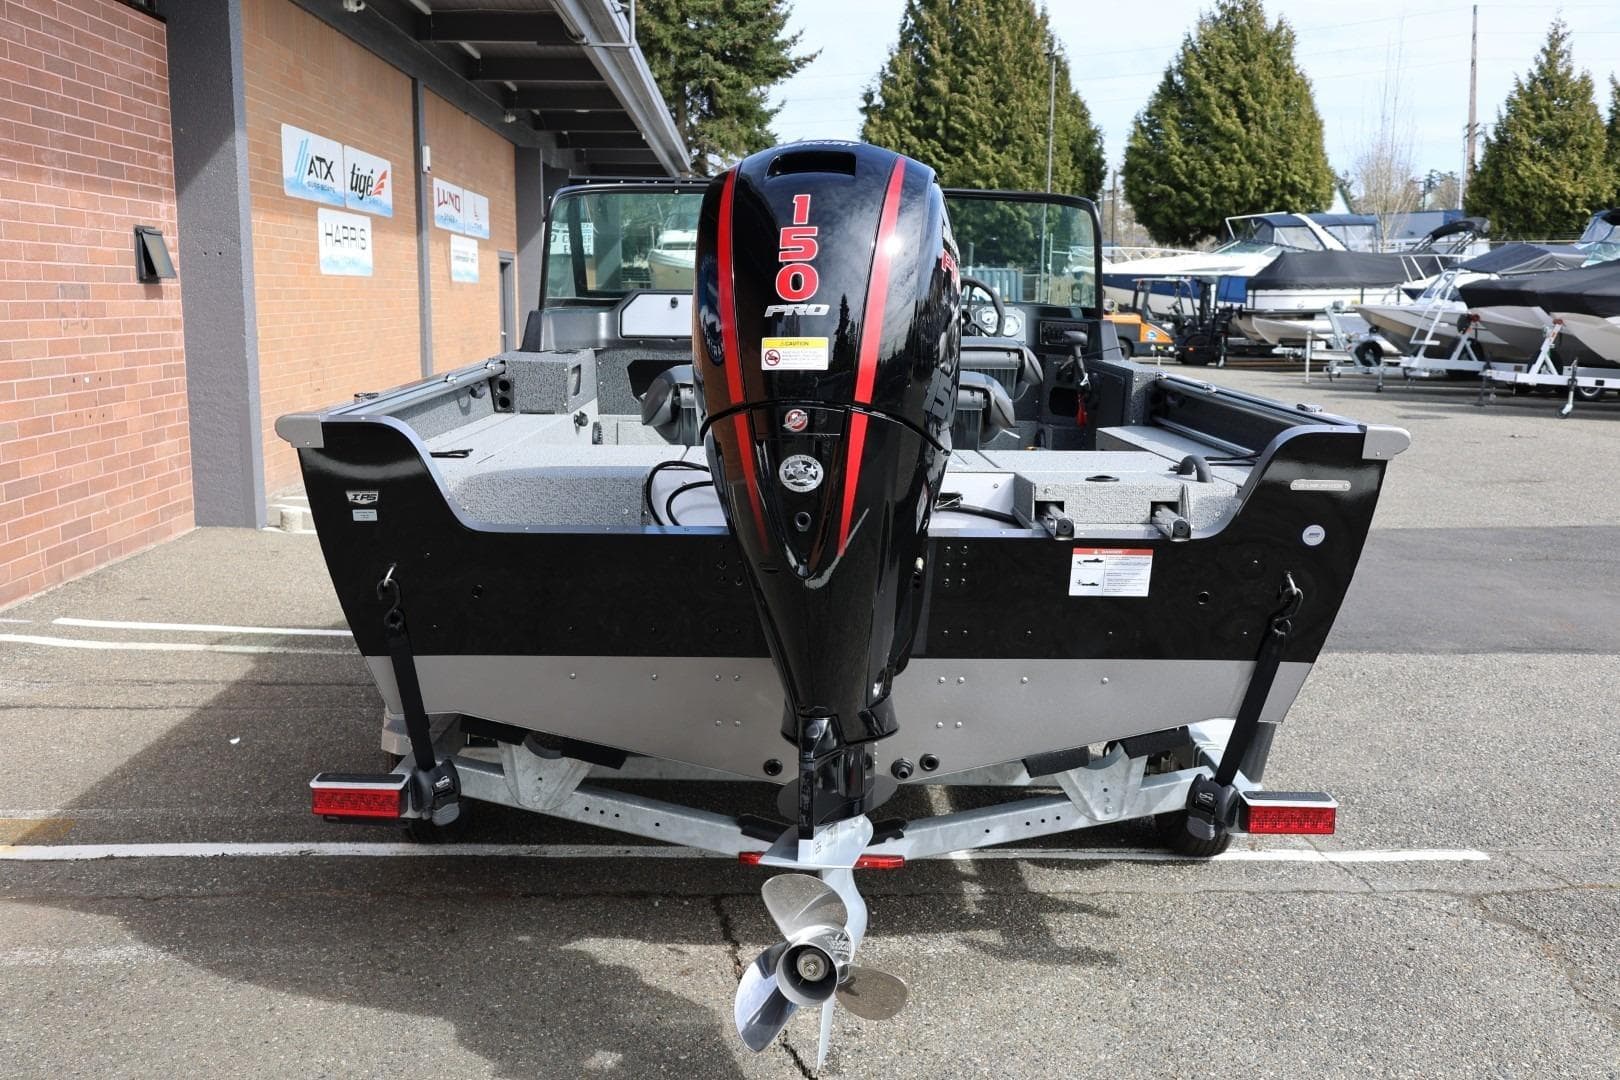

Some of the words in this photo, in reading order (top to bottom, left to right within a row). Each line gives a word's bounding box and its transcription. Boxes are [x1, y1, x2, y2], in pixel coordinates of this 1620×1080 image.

[307, 155, 335, 184] ATX
[437, 187, 461, 213] LUND
[324, 222, 367, 250] HARRIS
[775, 193, 819, 302] 150
[764, 304, 830, 317] PRO
